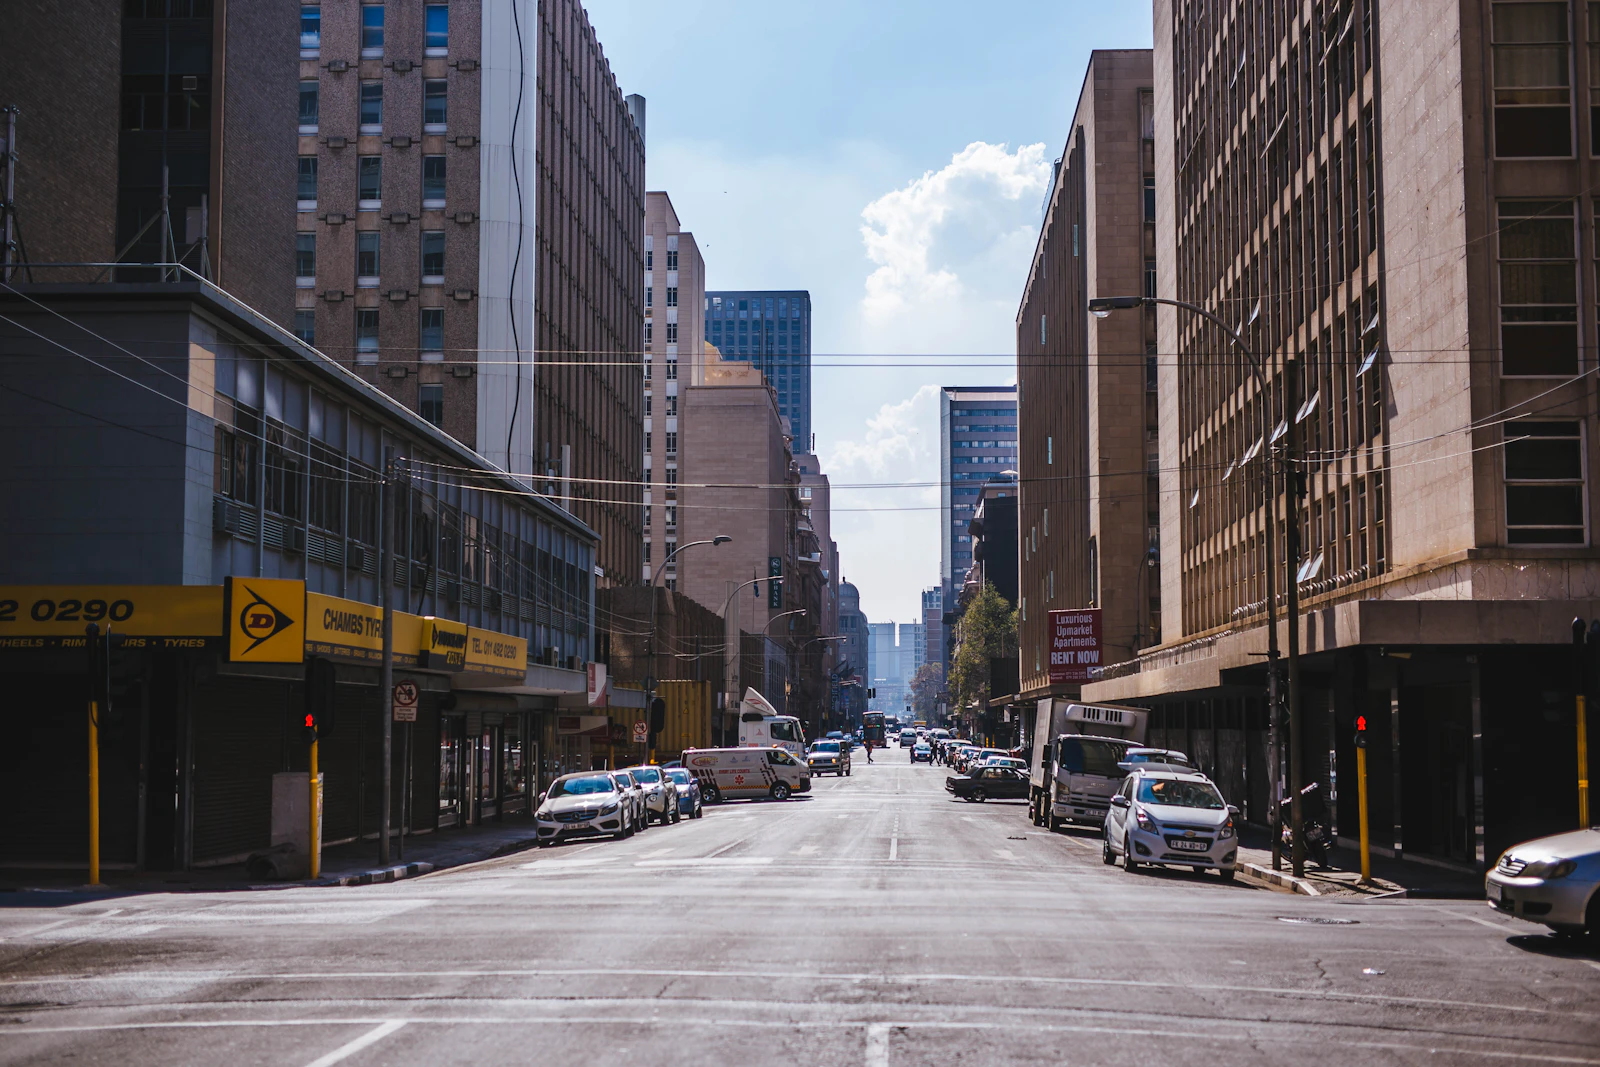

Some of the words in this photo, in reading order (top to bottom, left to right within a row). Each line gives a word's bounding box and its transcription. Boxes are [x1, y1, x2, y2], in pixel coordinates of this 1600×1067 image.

[31, 599, 134, 621] 0290
[248, 613, 274, 629] D
[323, 608, 364, 636] CHAMBS
[1056, 613, 1093, 625] Luxurious
[1056, 625, 1093, 638] Upmarket
[0, 639, 44, 648] HEELS
[164, 639, 206, 648] TYRES
[1053, 636, 1097, 649] Apartments
[484, 640, 493, 656] 011
[493, 642, 503, 658] 492
[504, 644, 517, 660] 0290
[1051, 651, 1075, 664] RENT
[1077, 650, 1100, 664] NOW
